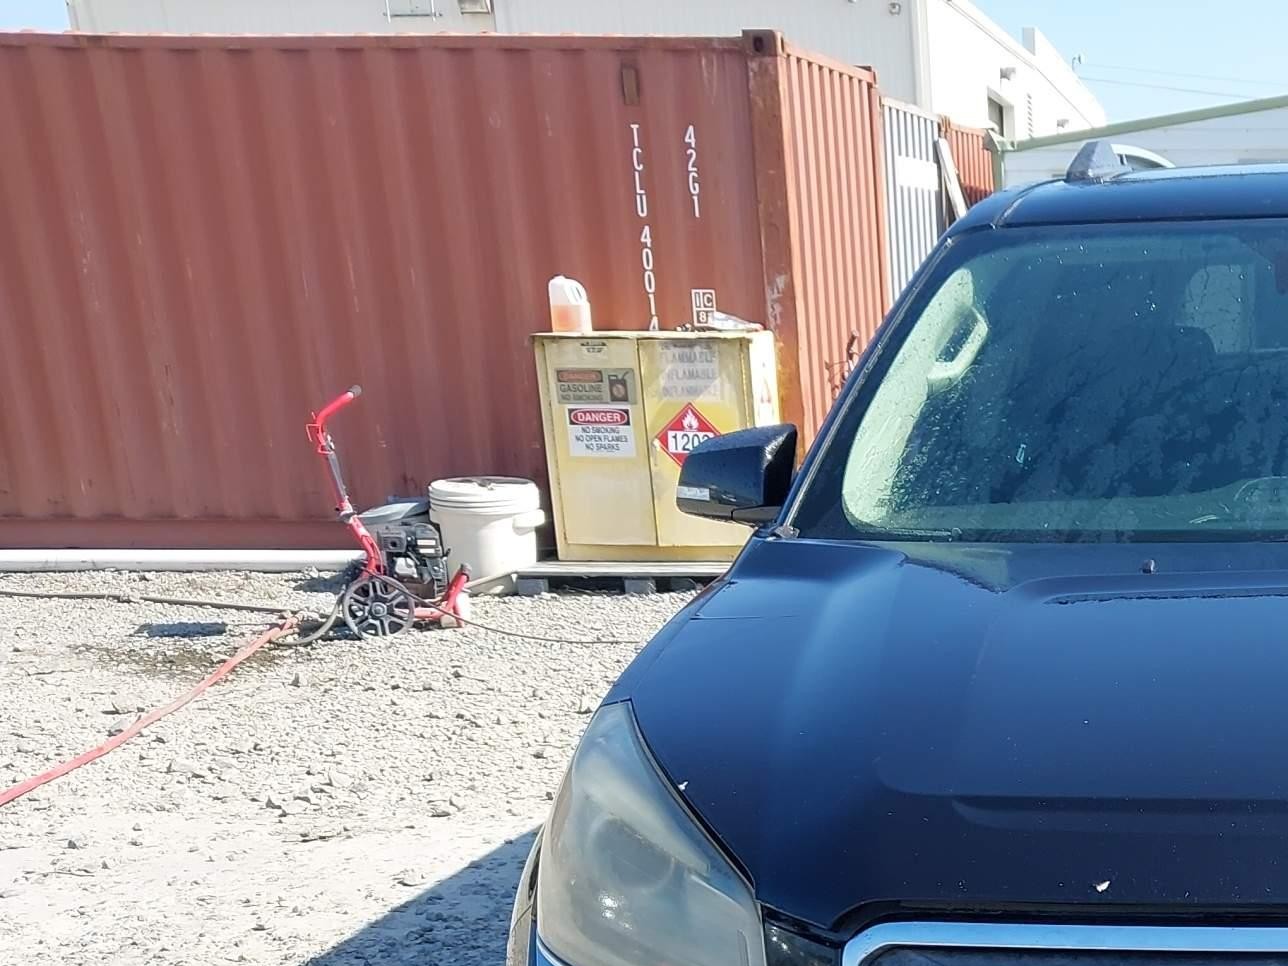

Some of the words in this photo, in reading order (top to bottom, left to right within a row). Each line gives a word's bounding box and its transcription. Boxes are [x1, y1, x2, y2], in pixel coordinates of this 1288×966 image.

[630, 124, 648, 217] TCLU
[684, 125, 700, 218] 42G1
[695, 293, 713, 307] IC
[560, 384, 603, 393] GASOLINE
[577, 412, 621, 422] DANGER
[604, 435, 628, 443] FLAMES
[596, 443, 620, 451] SPARKS
